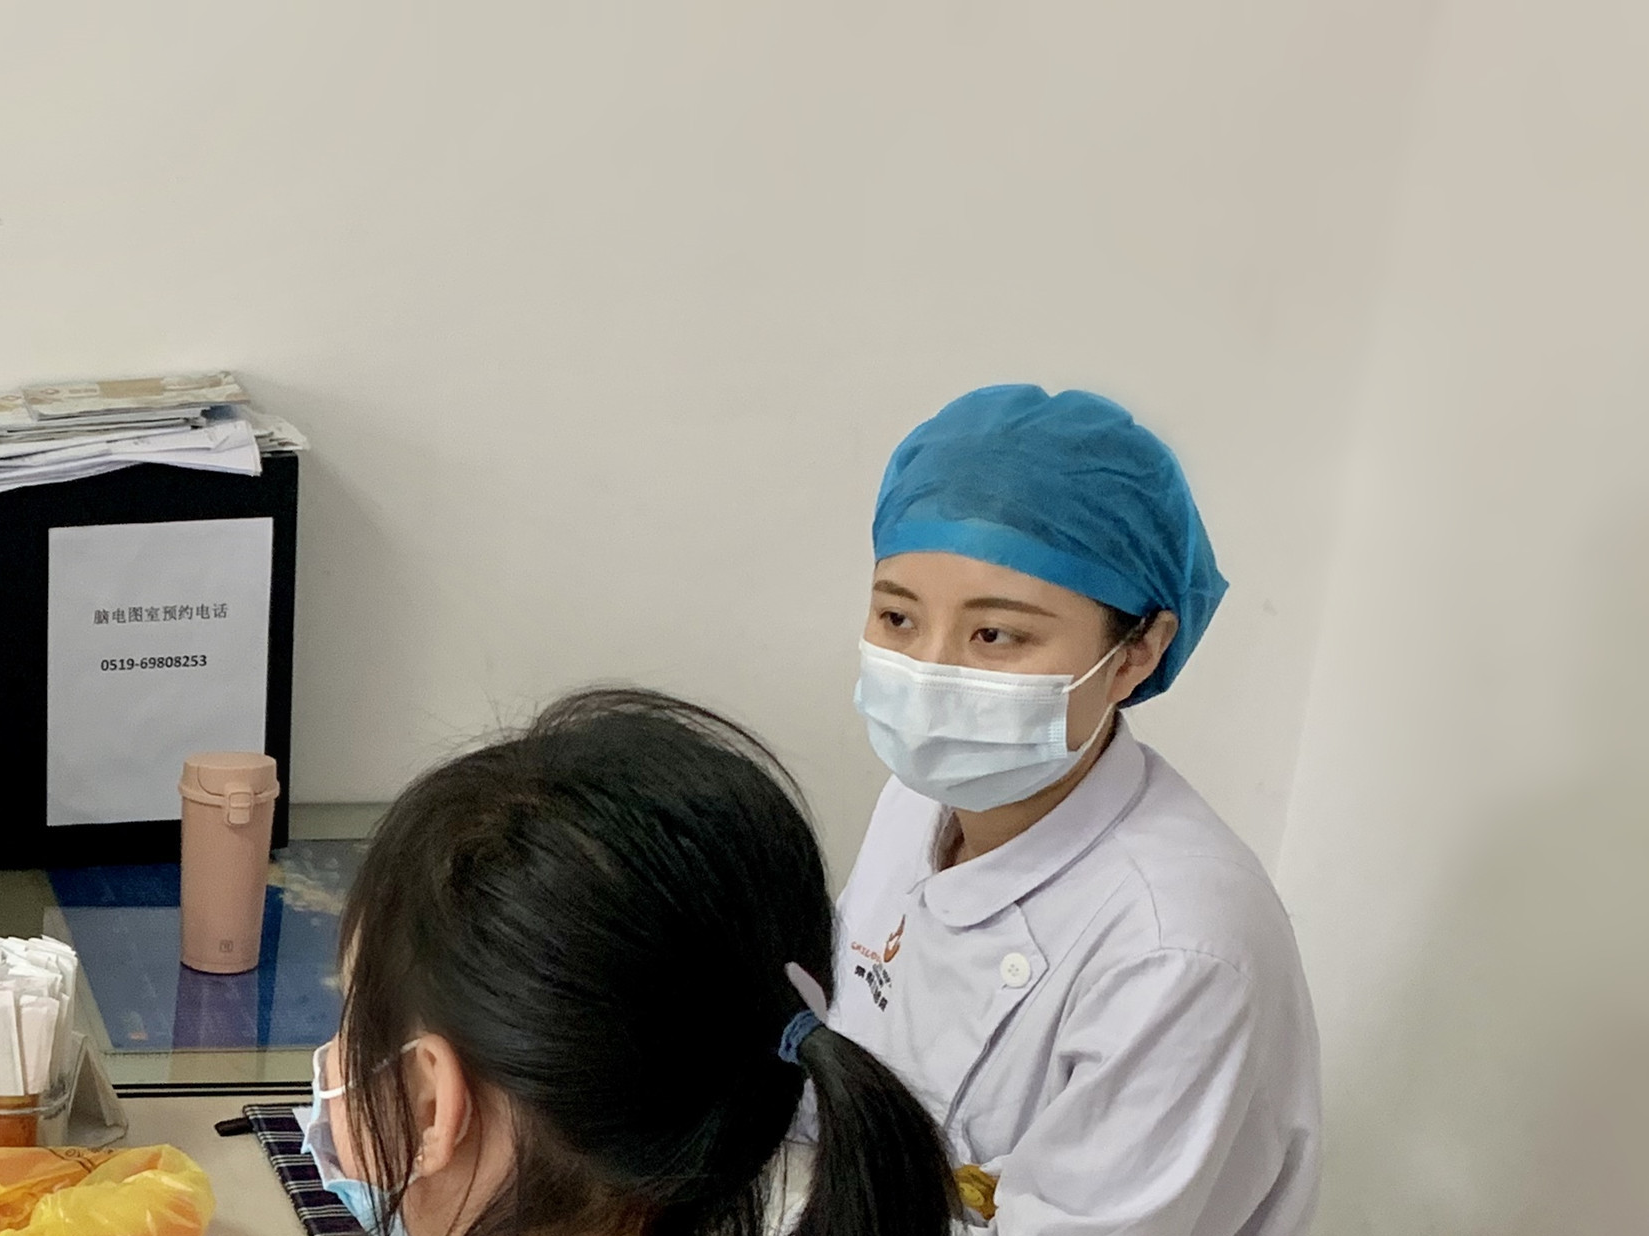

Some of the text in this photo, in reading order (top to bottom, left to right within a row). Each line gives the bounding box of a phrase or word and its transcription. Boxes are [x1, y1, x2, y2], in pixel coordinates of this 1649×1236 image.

[93, 602, 229, 626] 脑电图室预约电话
[100, 654, 208, 672] 0519-69808253
